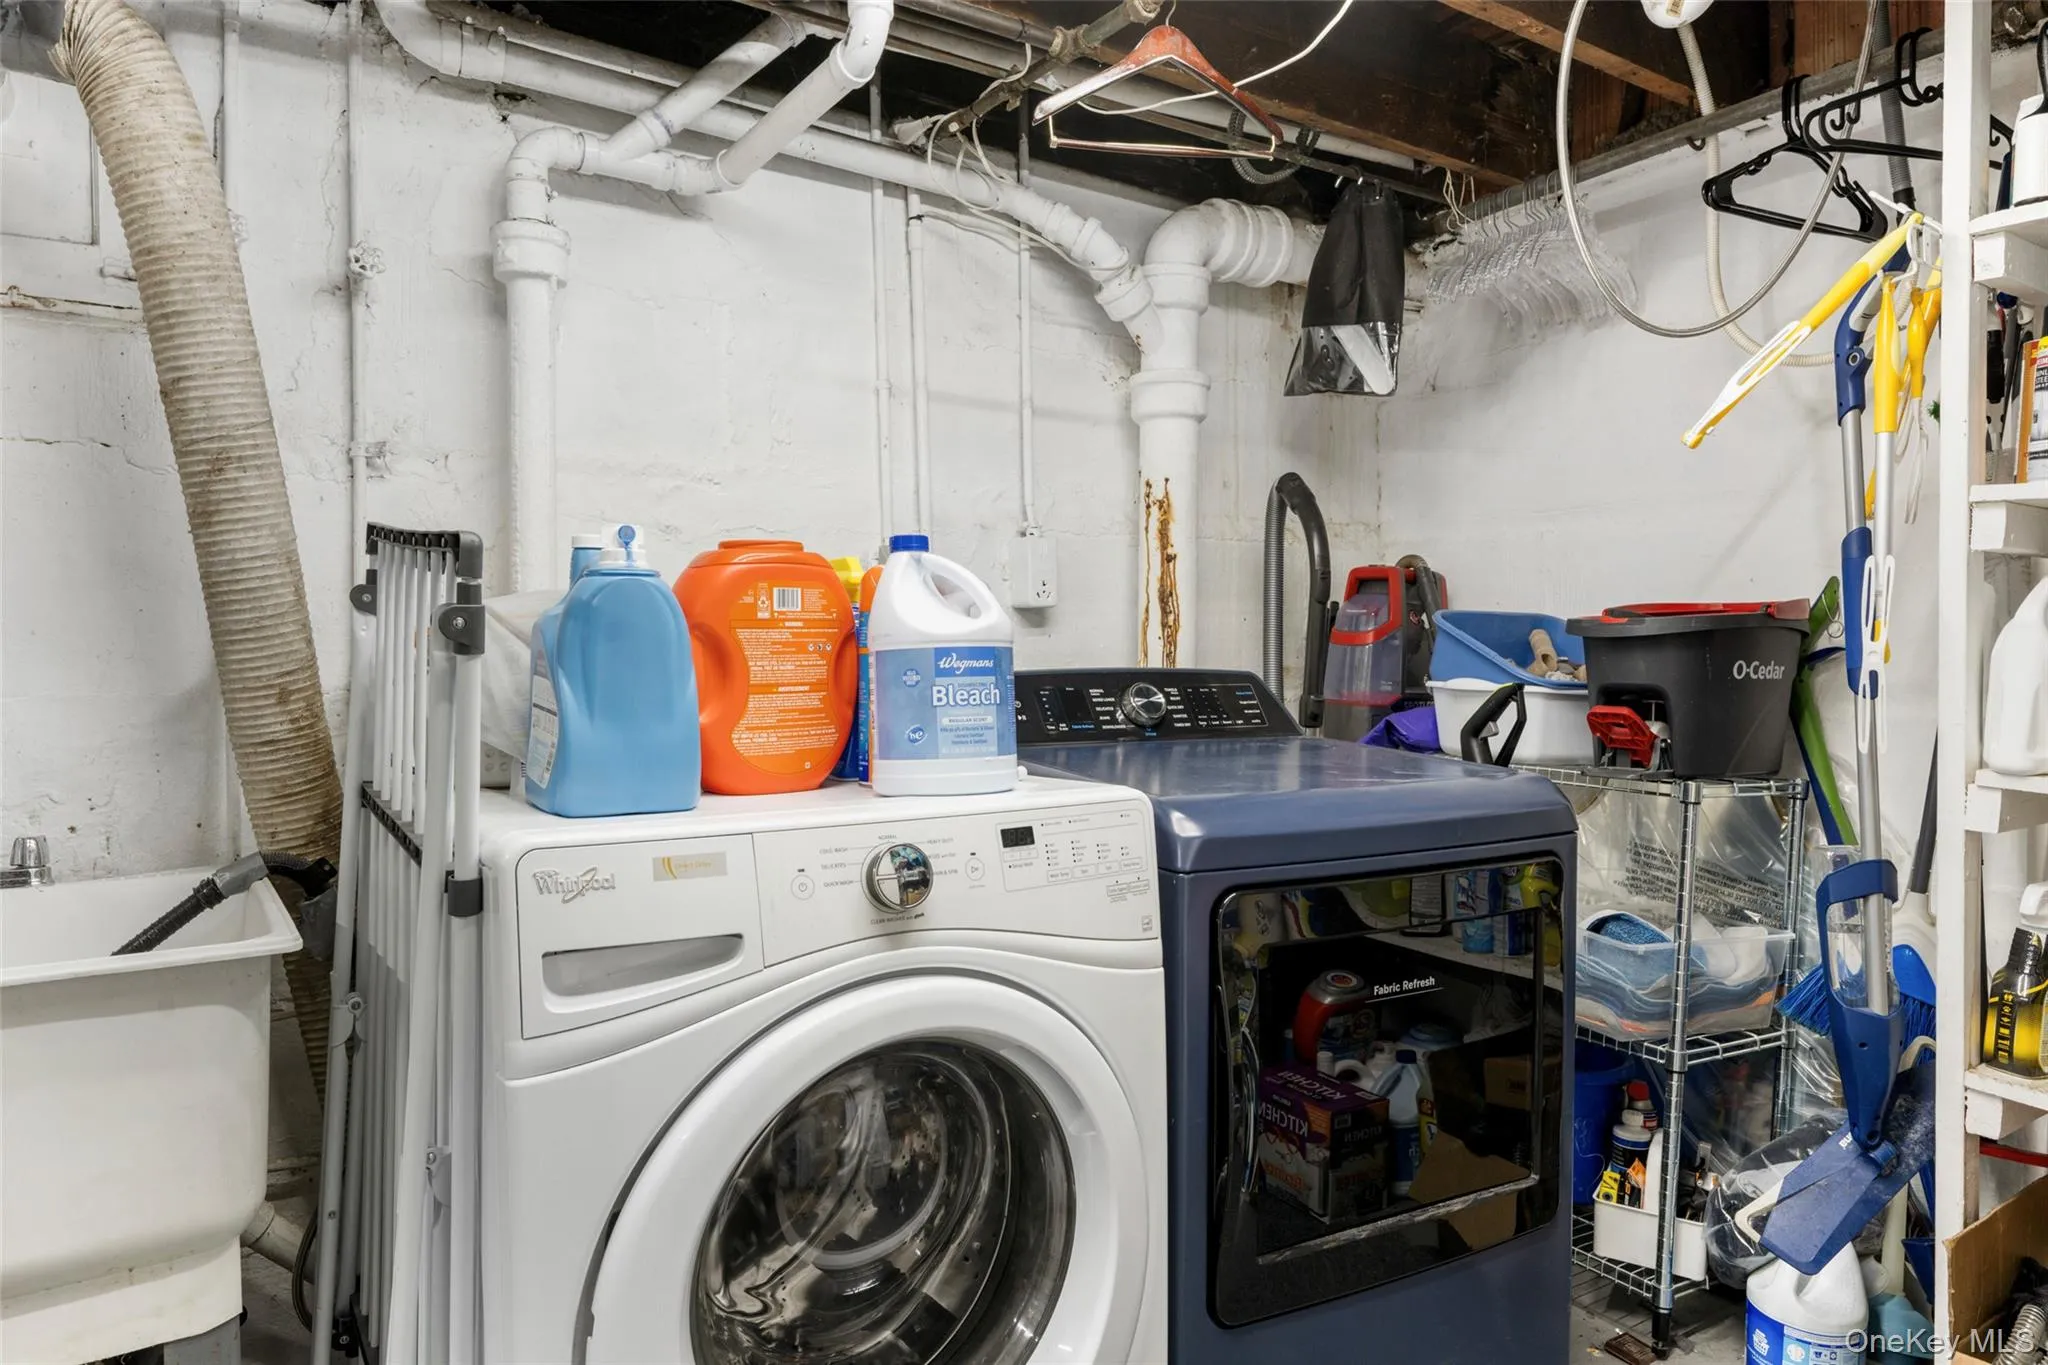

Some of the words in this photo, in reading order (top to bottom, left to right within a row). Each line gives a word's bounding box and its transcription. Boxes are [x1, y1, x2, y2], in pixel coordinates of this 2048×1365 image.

[937, 652, 994, 675] Wegmans
[1733, 660, 1785, 680] O-Cedar
[931, 682, 1000, 707] Bleach
[533, 868, 616, 900] Whirlpool
[1373, 982, 1401, 996] Fabric
[1402, 975, 1435, 991] Refresh
